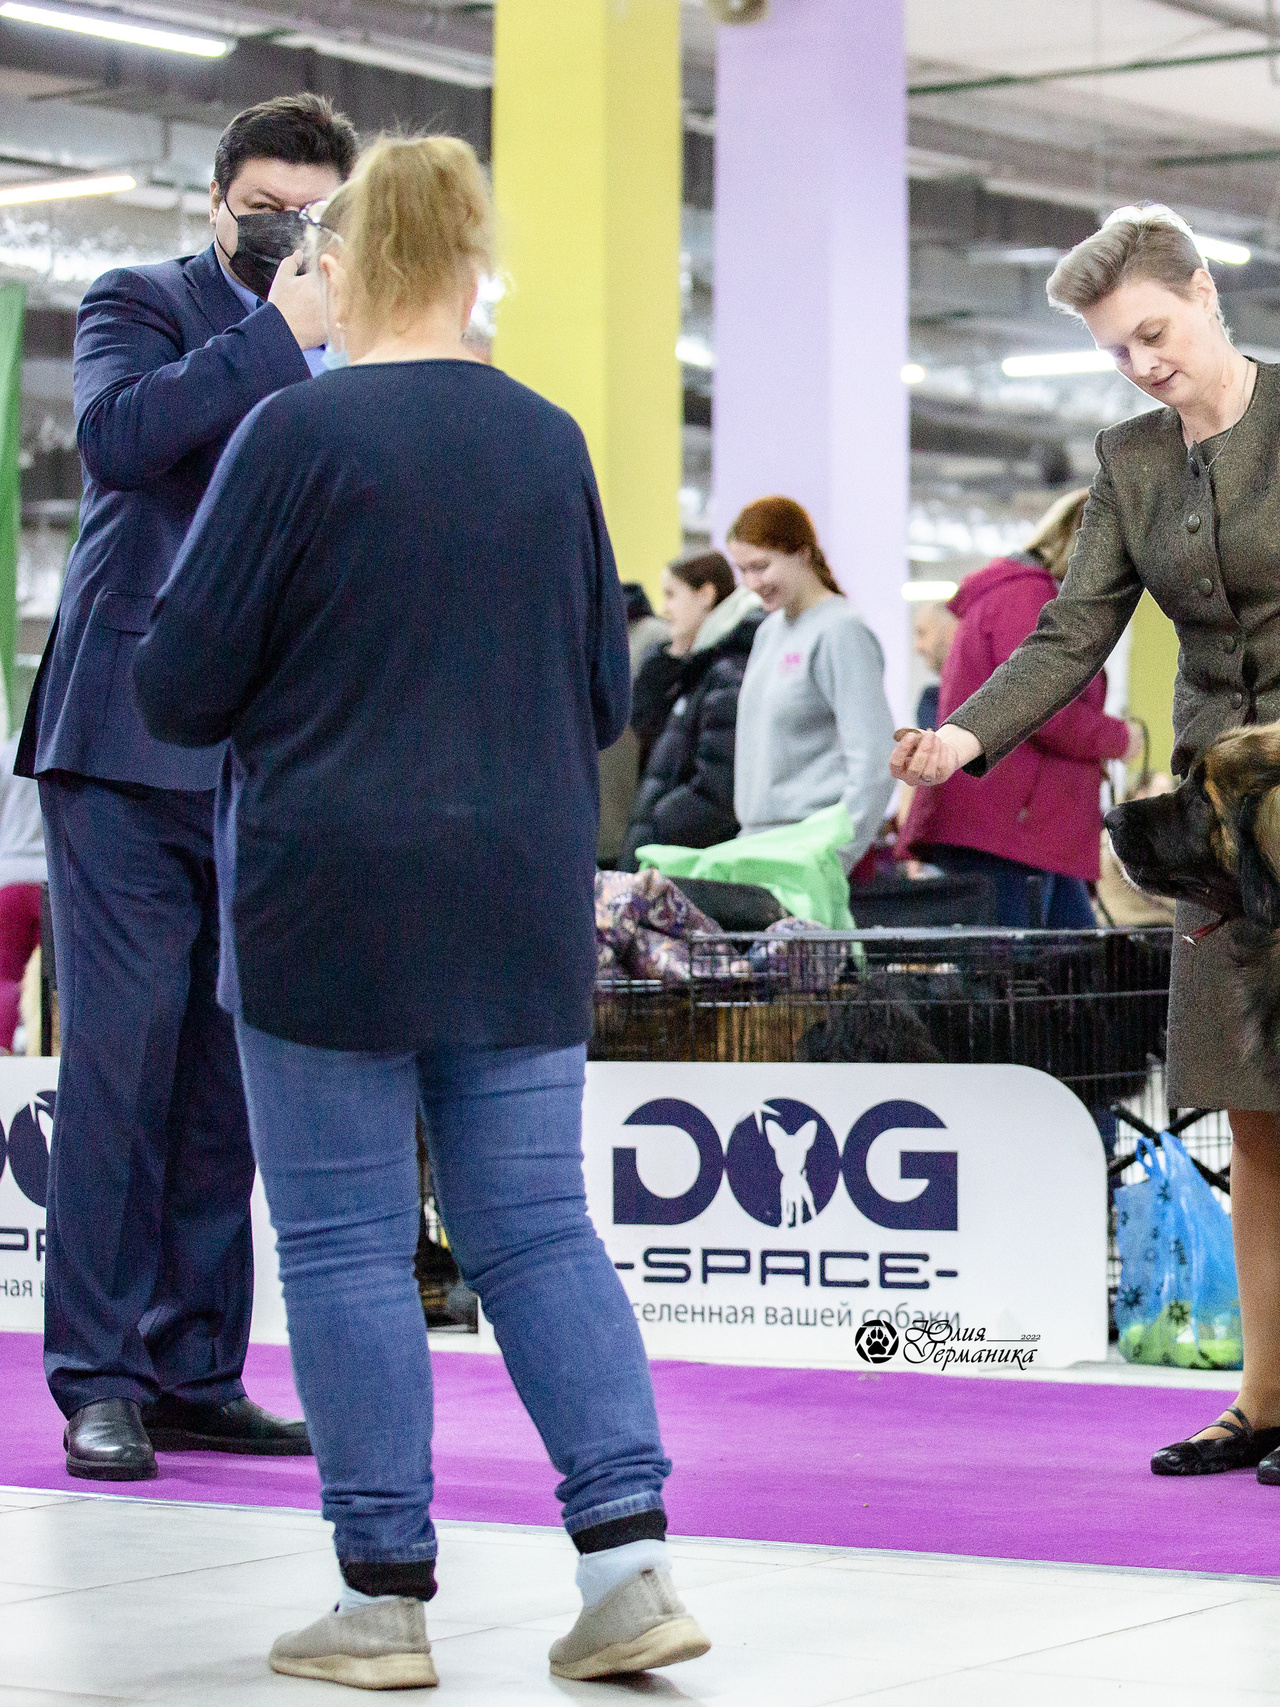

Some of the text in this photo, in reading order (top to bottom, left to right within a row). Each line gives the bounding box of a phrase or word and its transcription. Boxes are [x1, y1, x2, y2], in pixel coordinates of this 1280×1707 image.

[612, 1097, 959, 1231] DOG
[632, 1301, 960, 1330] еленная вашей собаки
